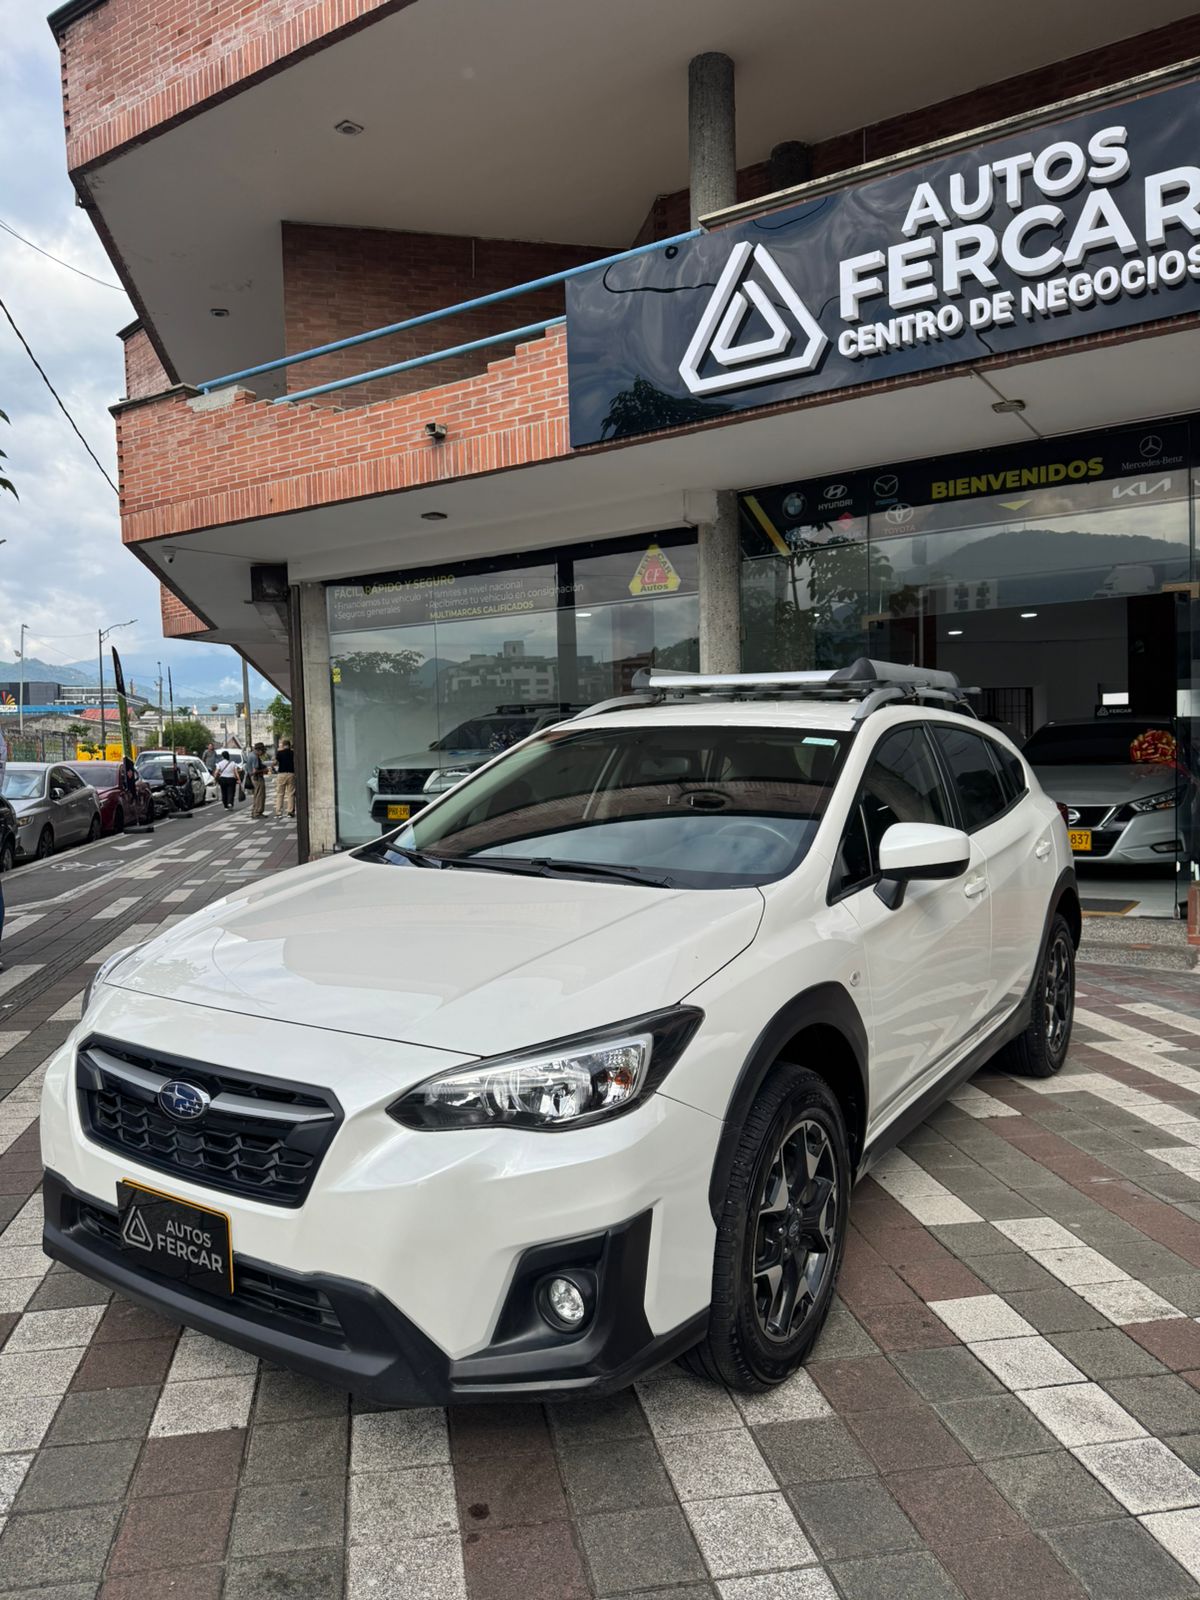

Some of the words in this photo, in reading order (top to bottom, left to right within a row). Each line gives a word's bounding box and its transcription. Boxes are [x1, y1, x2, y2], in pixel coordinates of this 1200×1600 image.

[901, 126, 1130, 237] AUTOS
[838, 166, 1200, 322] FERCAR
[837, 305, 963, 360] CENTRO
[968, 291, 1015, 332] DE
[1020, 243, 1200, 319] NEGOCIOS
[1122, 455, 1183, 471] Mercedes-Benz
[931, 457, 1104, 499] BIENVENIDOS
[818, 498, 853, 511] HYUNDAI
[884, 525, 916, 534] TOYOTA
[413, 574, 455, 589] SEGURO
[489, 580, 523, 591] nacional
[640, 584, 669, 593] Autos
[483, 600, 534, 614] CALIFICADOS
[1070, 833, 1090, 845] 837
[166, 1219, 211, 1248] AUTOS
[156, 1233, 224, 1274] FERCAR
